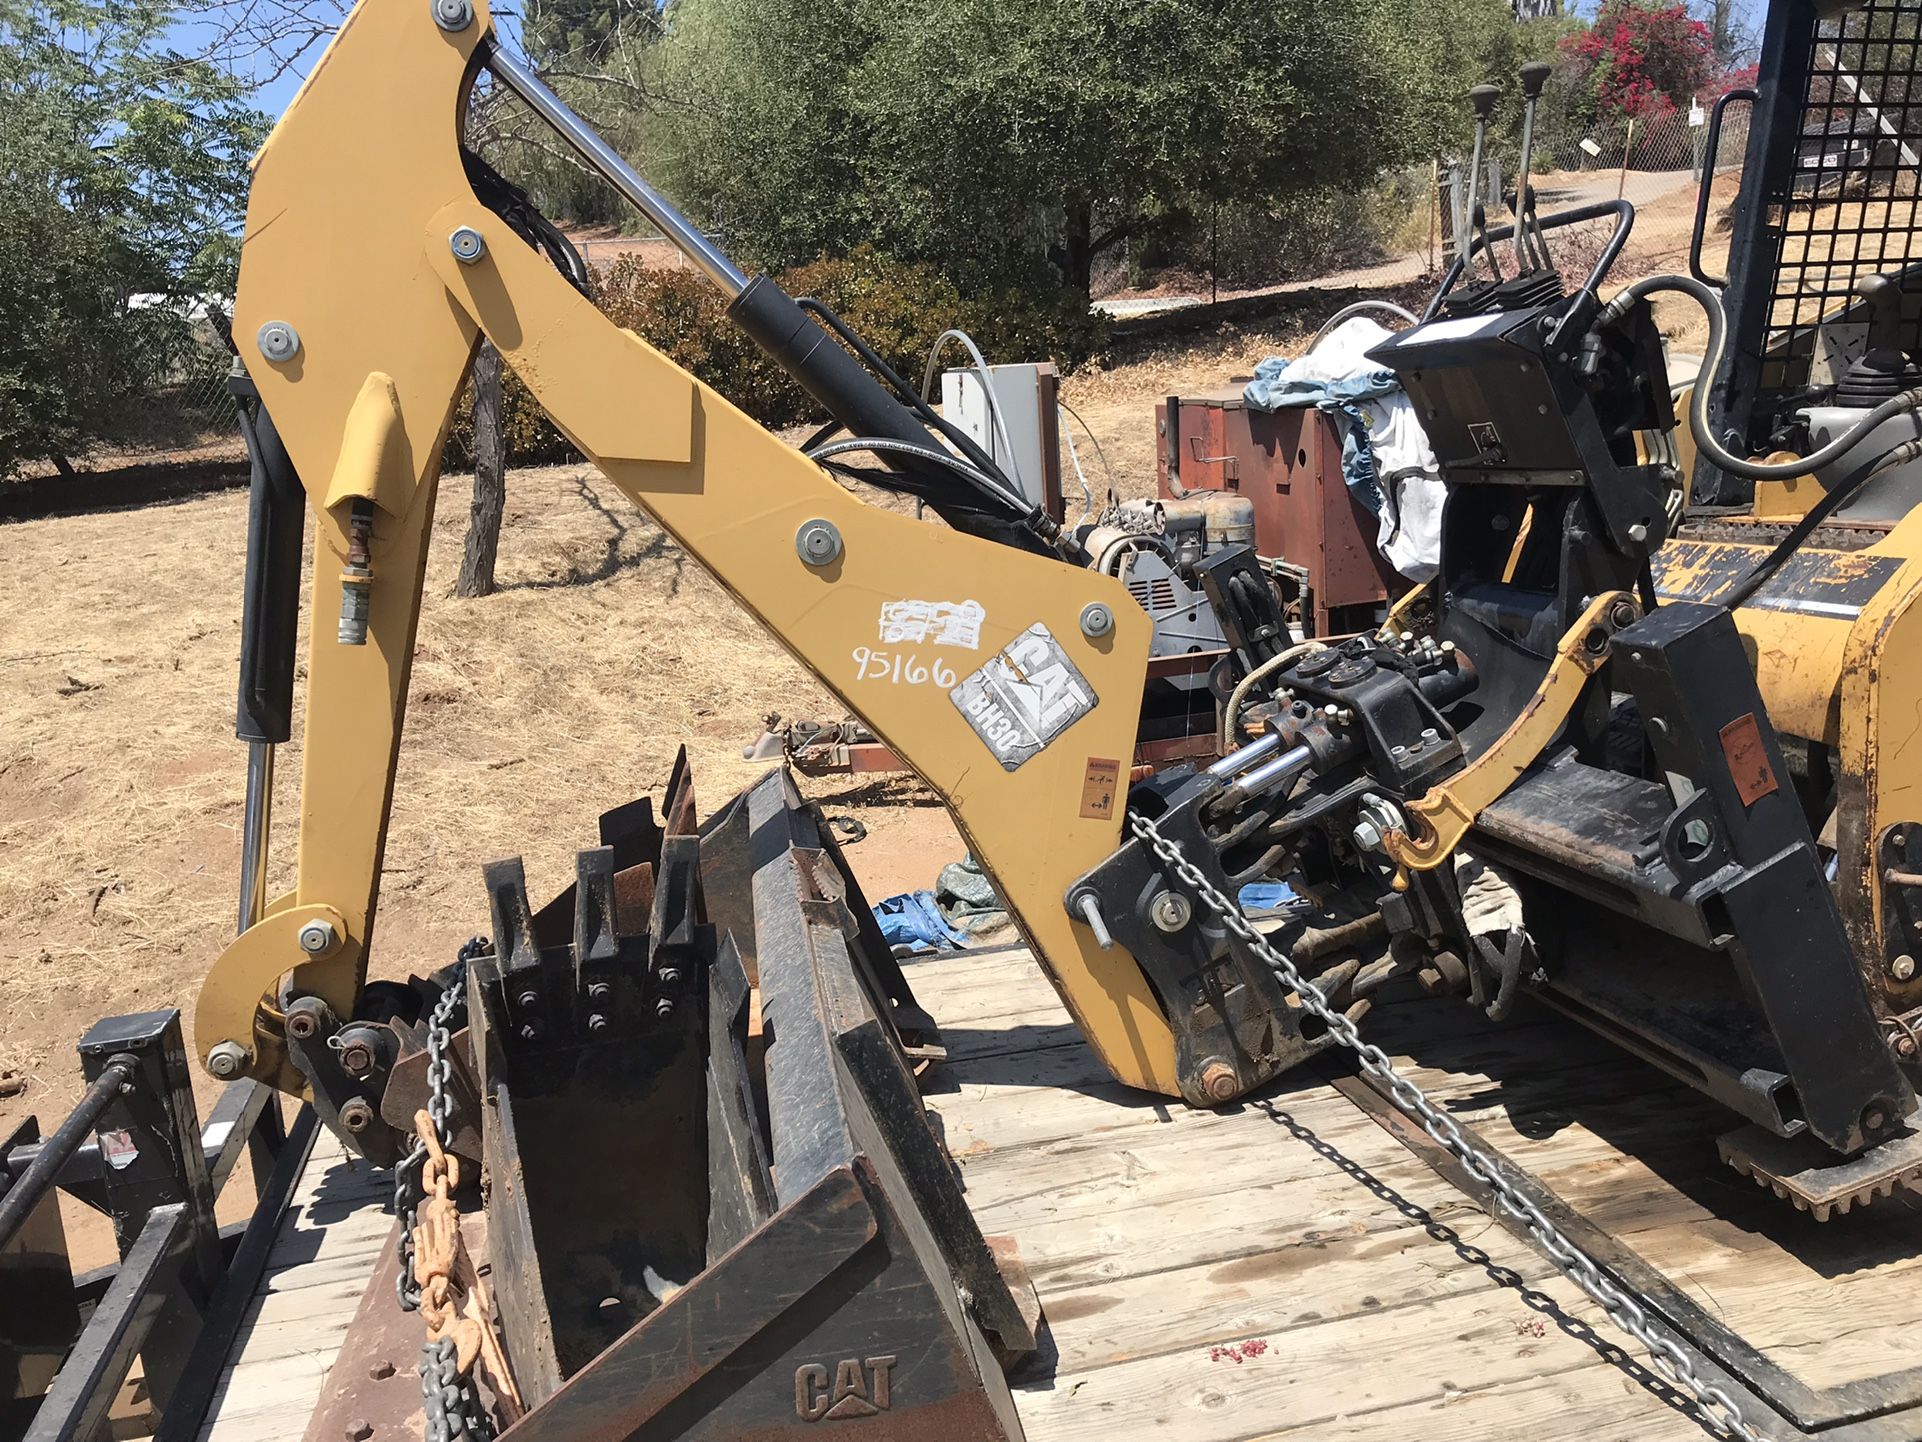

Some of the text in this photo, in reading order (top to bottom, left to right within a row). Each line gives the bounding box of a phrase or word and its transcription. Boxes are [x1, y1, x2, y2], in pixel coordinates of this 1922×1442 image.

[852, 646, 957, 688] 95166
[998, 636, 1089, 730] CAT
[966, 690, 1021, 752] BH30
[795, 1354, 897, 1422] CAT
